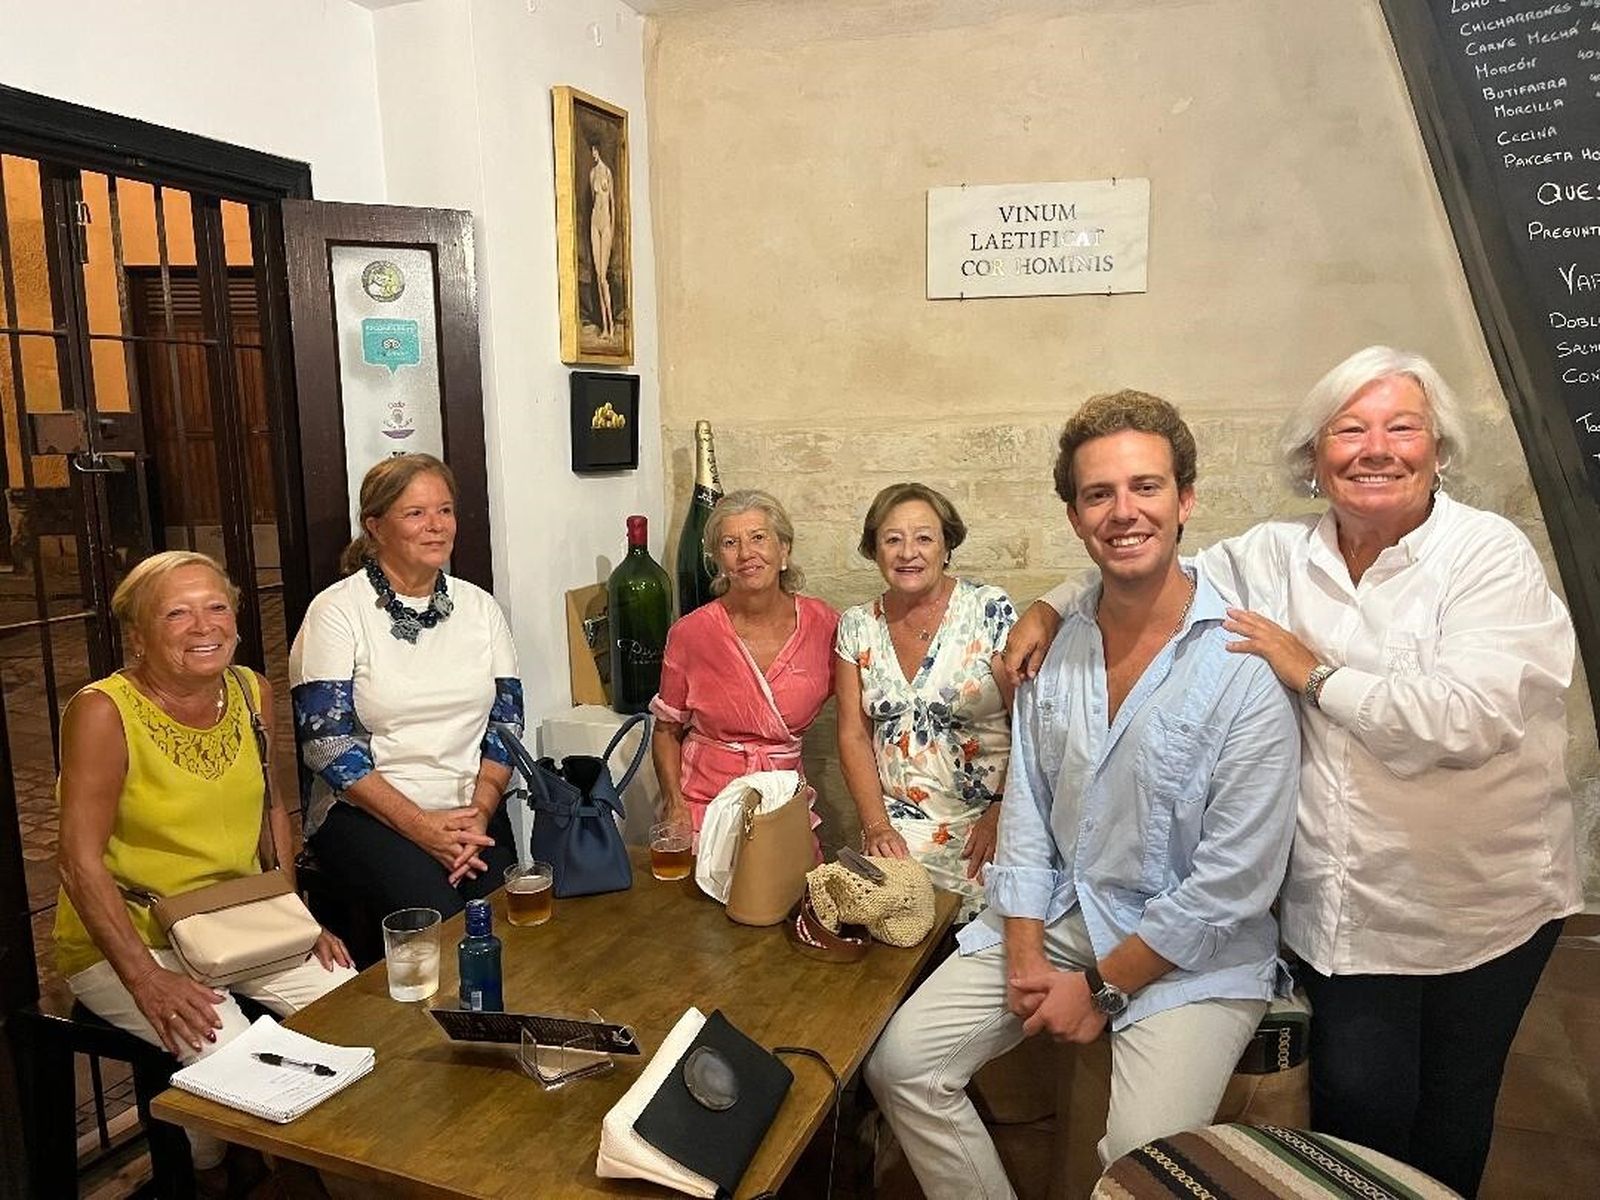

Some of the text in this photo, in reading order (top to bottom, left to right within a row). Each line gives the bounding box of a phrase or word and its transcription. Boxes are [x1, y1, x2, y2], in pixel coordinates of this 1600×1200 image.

[1460, 3, 1572, 36] CHICHARRONES
[1466, 38, 1516, 56] CARNE
[1483, 78, 1567, 100] BUTIFARRA
[1494, 98, 1564, 118] MORCILLA
[1497, 126, 1557, 145] CECINA
[1504, 151, 1573, 168] PANCETA
[999, 202, 1077, 224] VINUM
[970, 229, 1104, 252] LAETIFICAT
[1528, 221, 1600, 240] PREGUNT
[960, 255, 1114, 278] COR HOMINIS
[1549, 312, 1600, 328] DOBL
